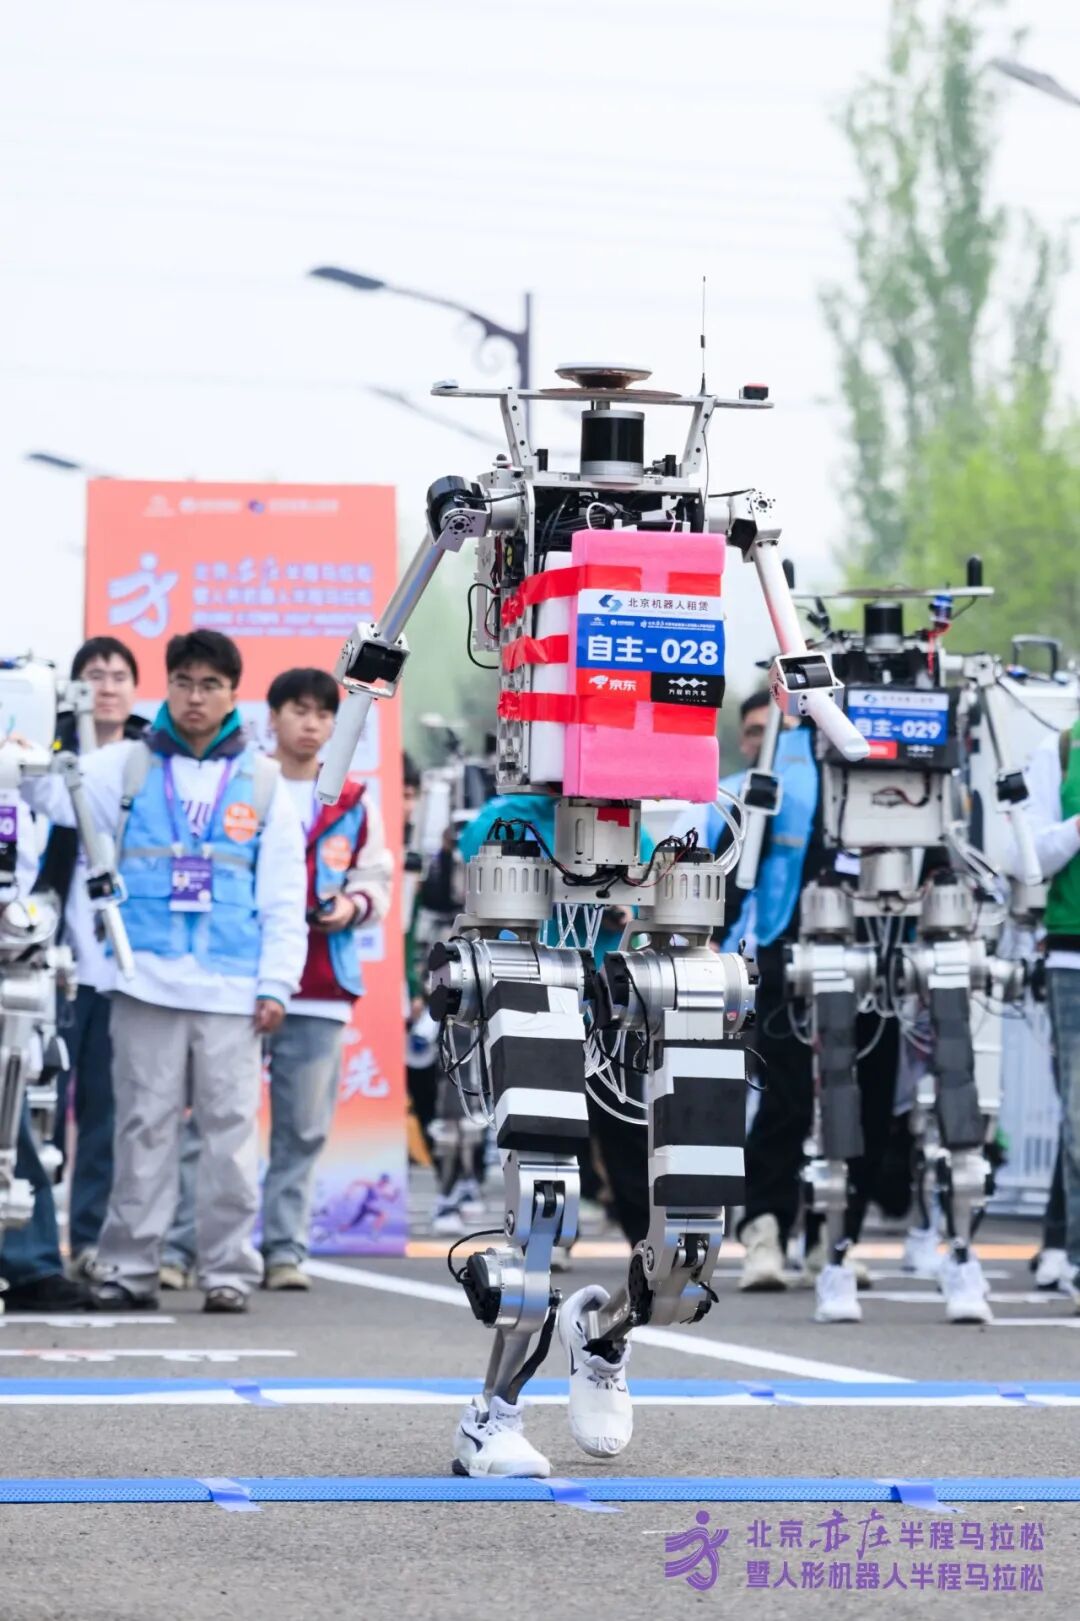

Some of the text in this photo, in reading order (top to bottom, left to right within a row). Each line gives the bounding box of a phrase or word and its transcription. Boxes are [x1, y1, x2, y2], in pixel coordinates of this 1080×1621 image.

[628, 597, 709, 612] 北京机器人租赁
[587, 634, 719, 666] 自主-028
[609, 678, 637, 692] 京东
[854, 717, 941, 740] 自主-029
